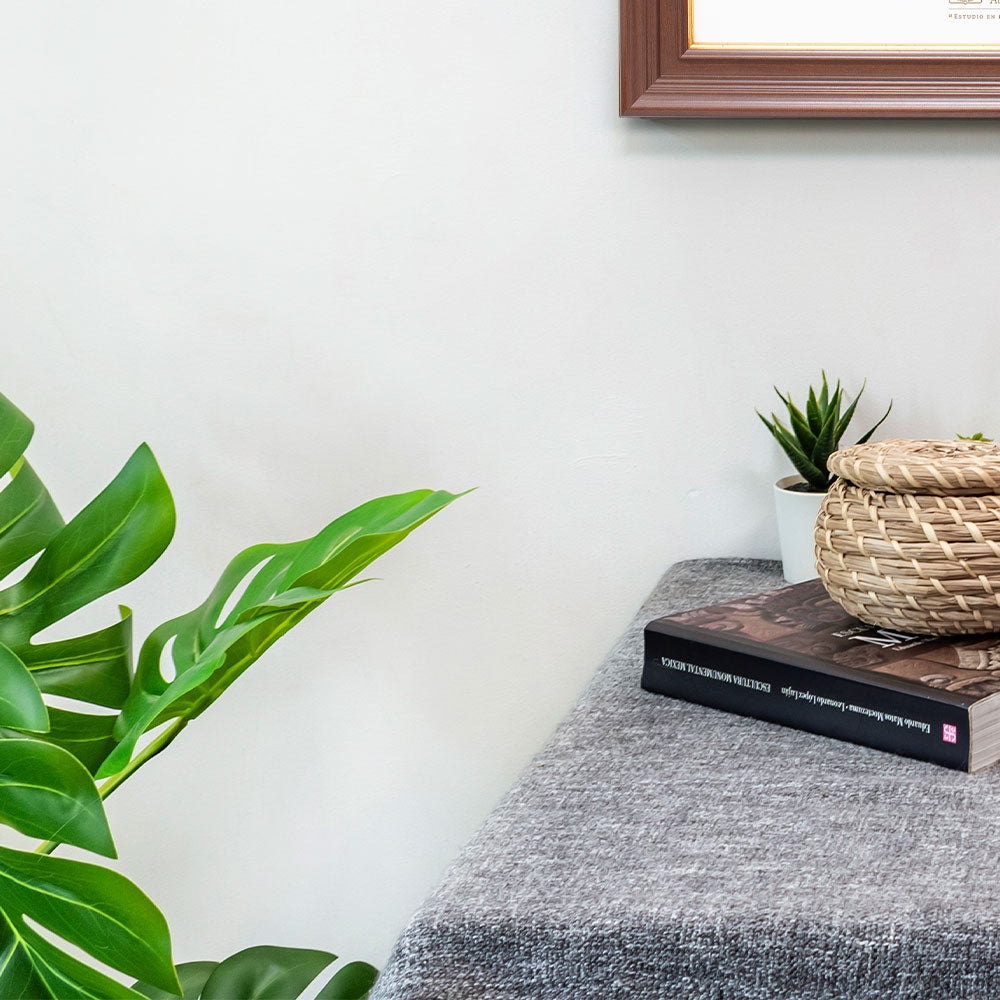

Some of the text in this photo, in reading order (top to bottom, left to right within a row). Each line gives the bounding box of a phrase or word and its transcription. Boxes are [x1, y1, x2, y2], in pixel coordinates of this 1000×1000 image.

[661, 656, 771, 693] ESCULTURA MONUMENTAL MEXICA
[816, 696, 845, 713] Leonardo
[848, 704, 884, 722] Moctezuma
[884, 713, 904, 727] Matos
[903, 717, 931, 734] Eduardo
